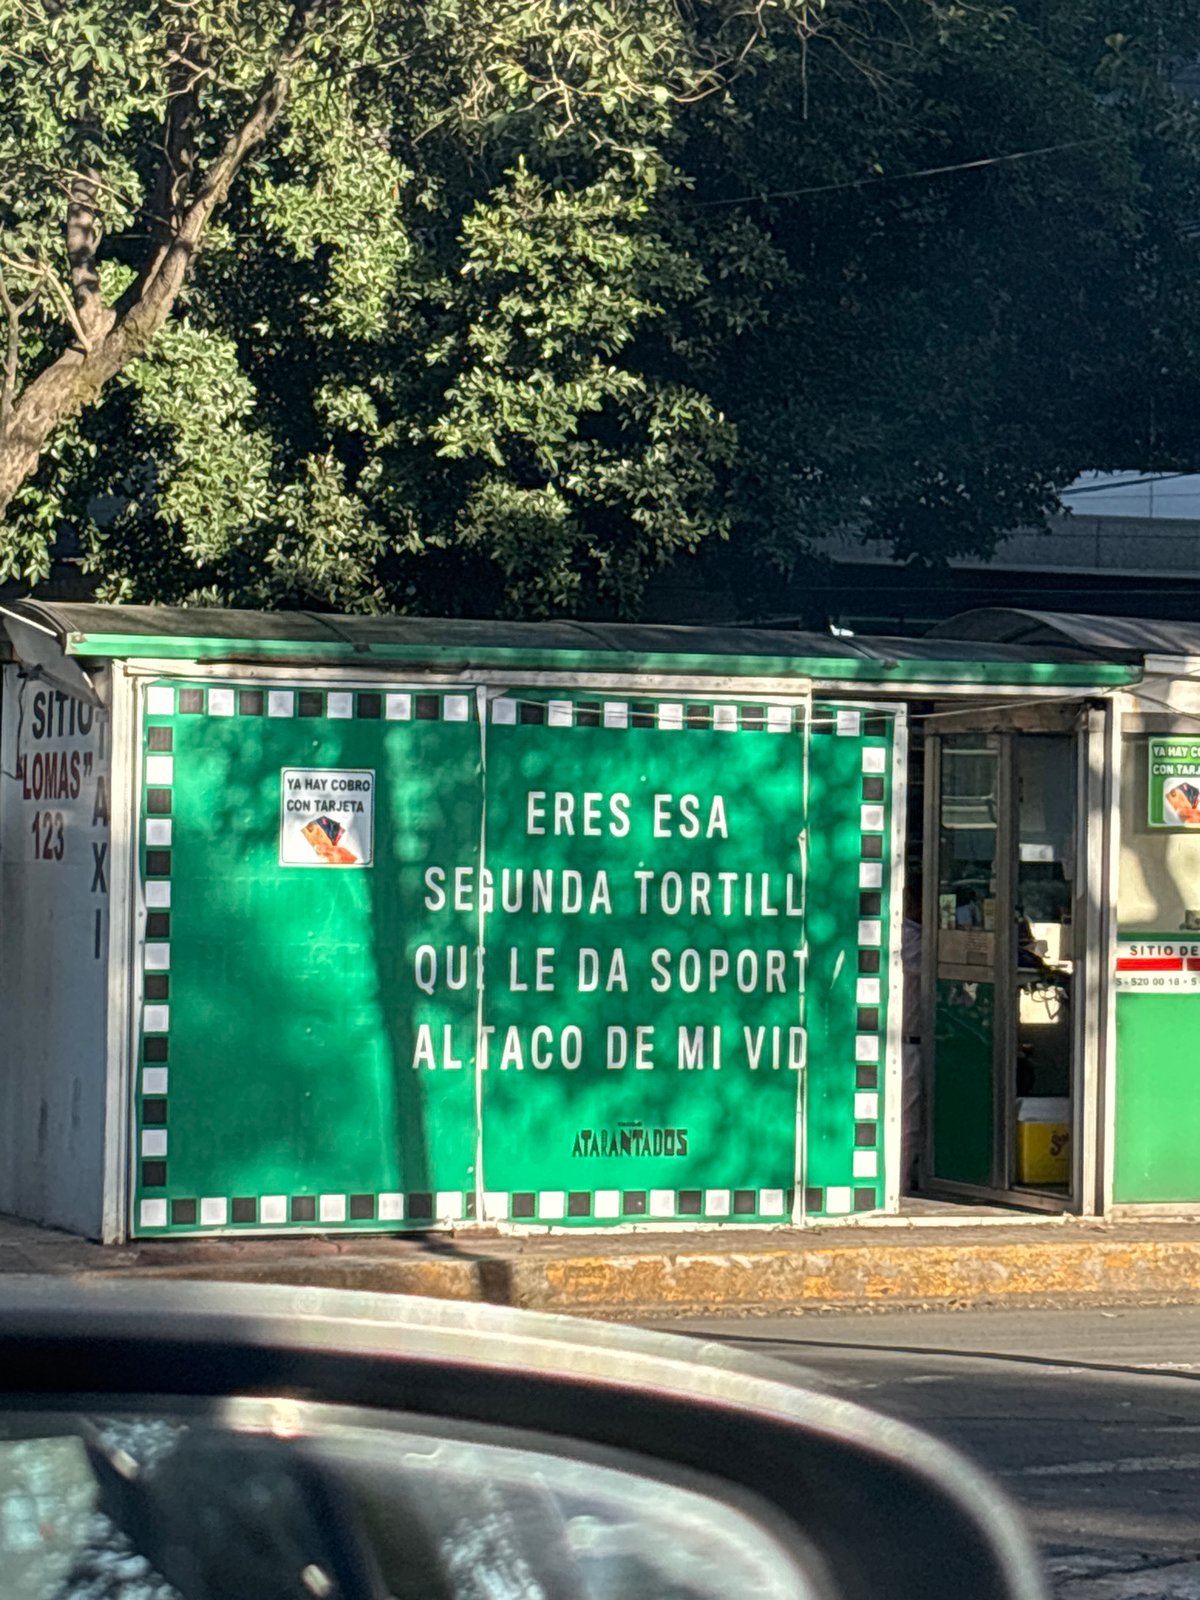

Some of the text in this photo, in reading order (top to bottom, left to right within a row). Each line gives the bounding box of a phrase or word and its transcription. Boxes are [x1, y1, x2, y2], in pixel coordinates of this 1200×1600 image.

[32, 690, 93, 739] SITIO
[1153, 746, 1200, 757] YA HAY C
[1153, 764, 1174, 775] CON
[287, 778, 370, 792] YA HAY COBRO
[286, 799, 364, 813] CON TARJETA
[527, 791, 728, 839] ERES ESA
[31, 811, 65, 861] 123
[424, 866, 613, 915] SEGUNDA
[1129, 945, 1199, 956] SITIO DE
[509, 947, 555, 992] LE
[578, 947, 629, 993] DA
[412, 1024, 462, 1070] AL
[480, 1025, 583, 1071] TACO
[607, 1025, 654, 1070] DE
[678, 1025, 721, 1070] MI
[572, 1128, 688, 1158] ATARANTADOS
